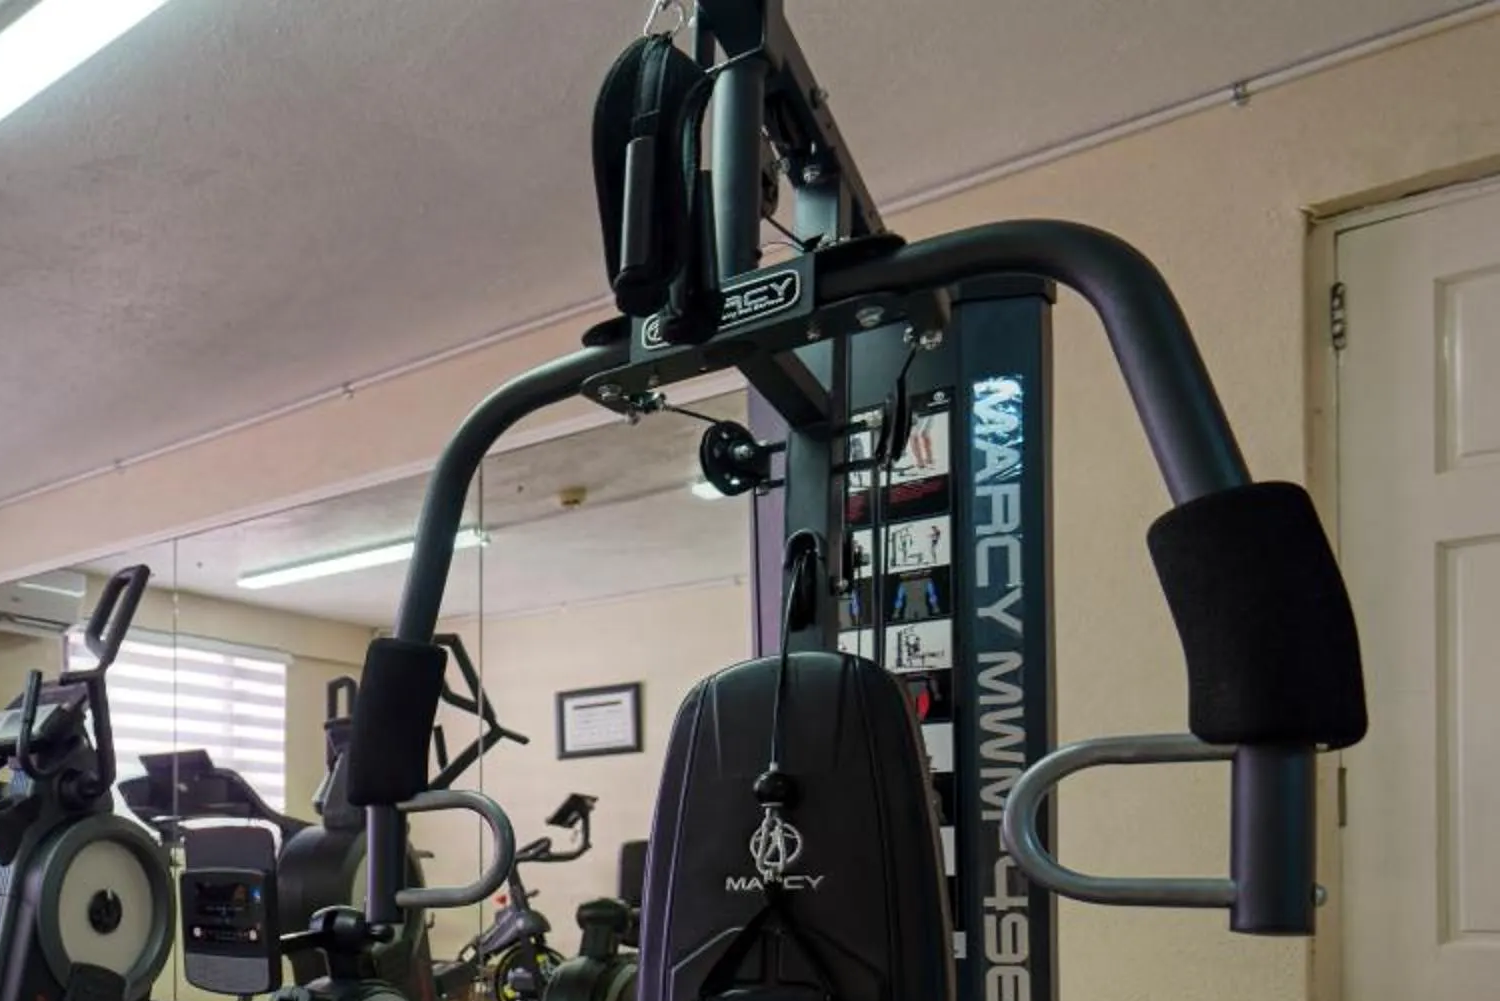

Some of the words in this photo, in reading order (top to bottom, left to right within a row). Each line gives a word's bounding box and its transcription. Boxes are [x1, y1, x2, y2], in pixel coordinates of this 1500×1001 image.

[724, 277, 793, 310] RCY
[974, 377, 1025, 635] MARCY
[725, 875, 825, 891] MACY
